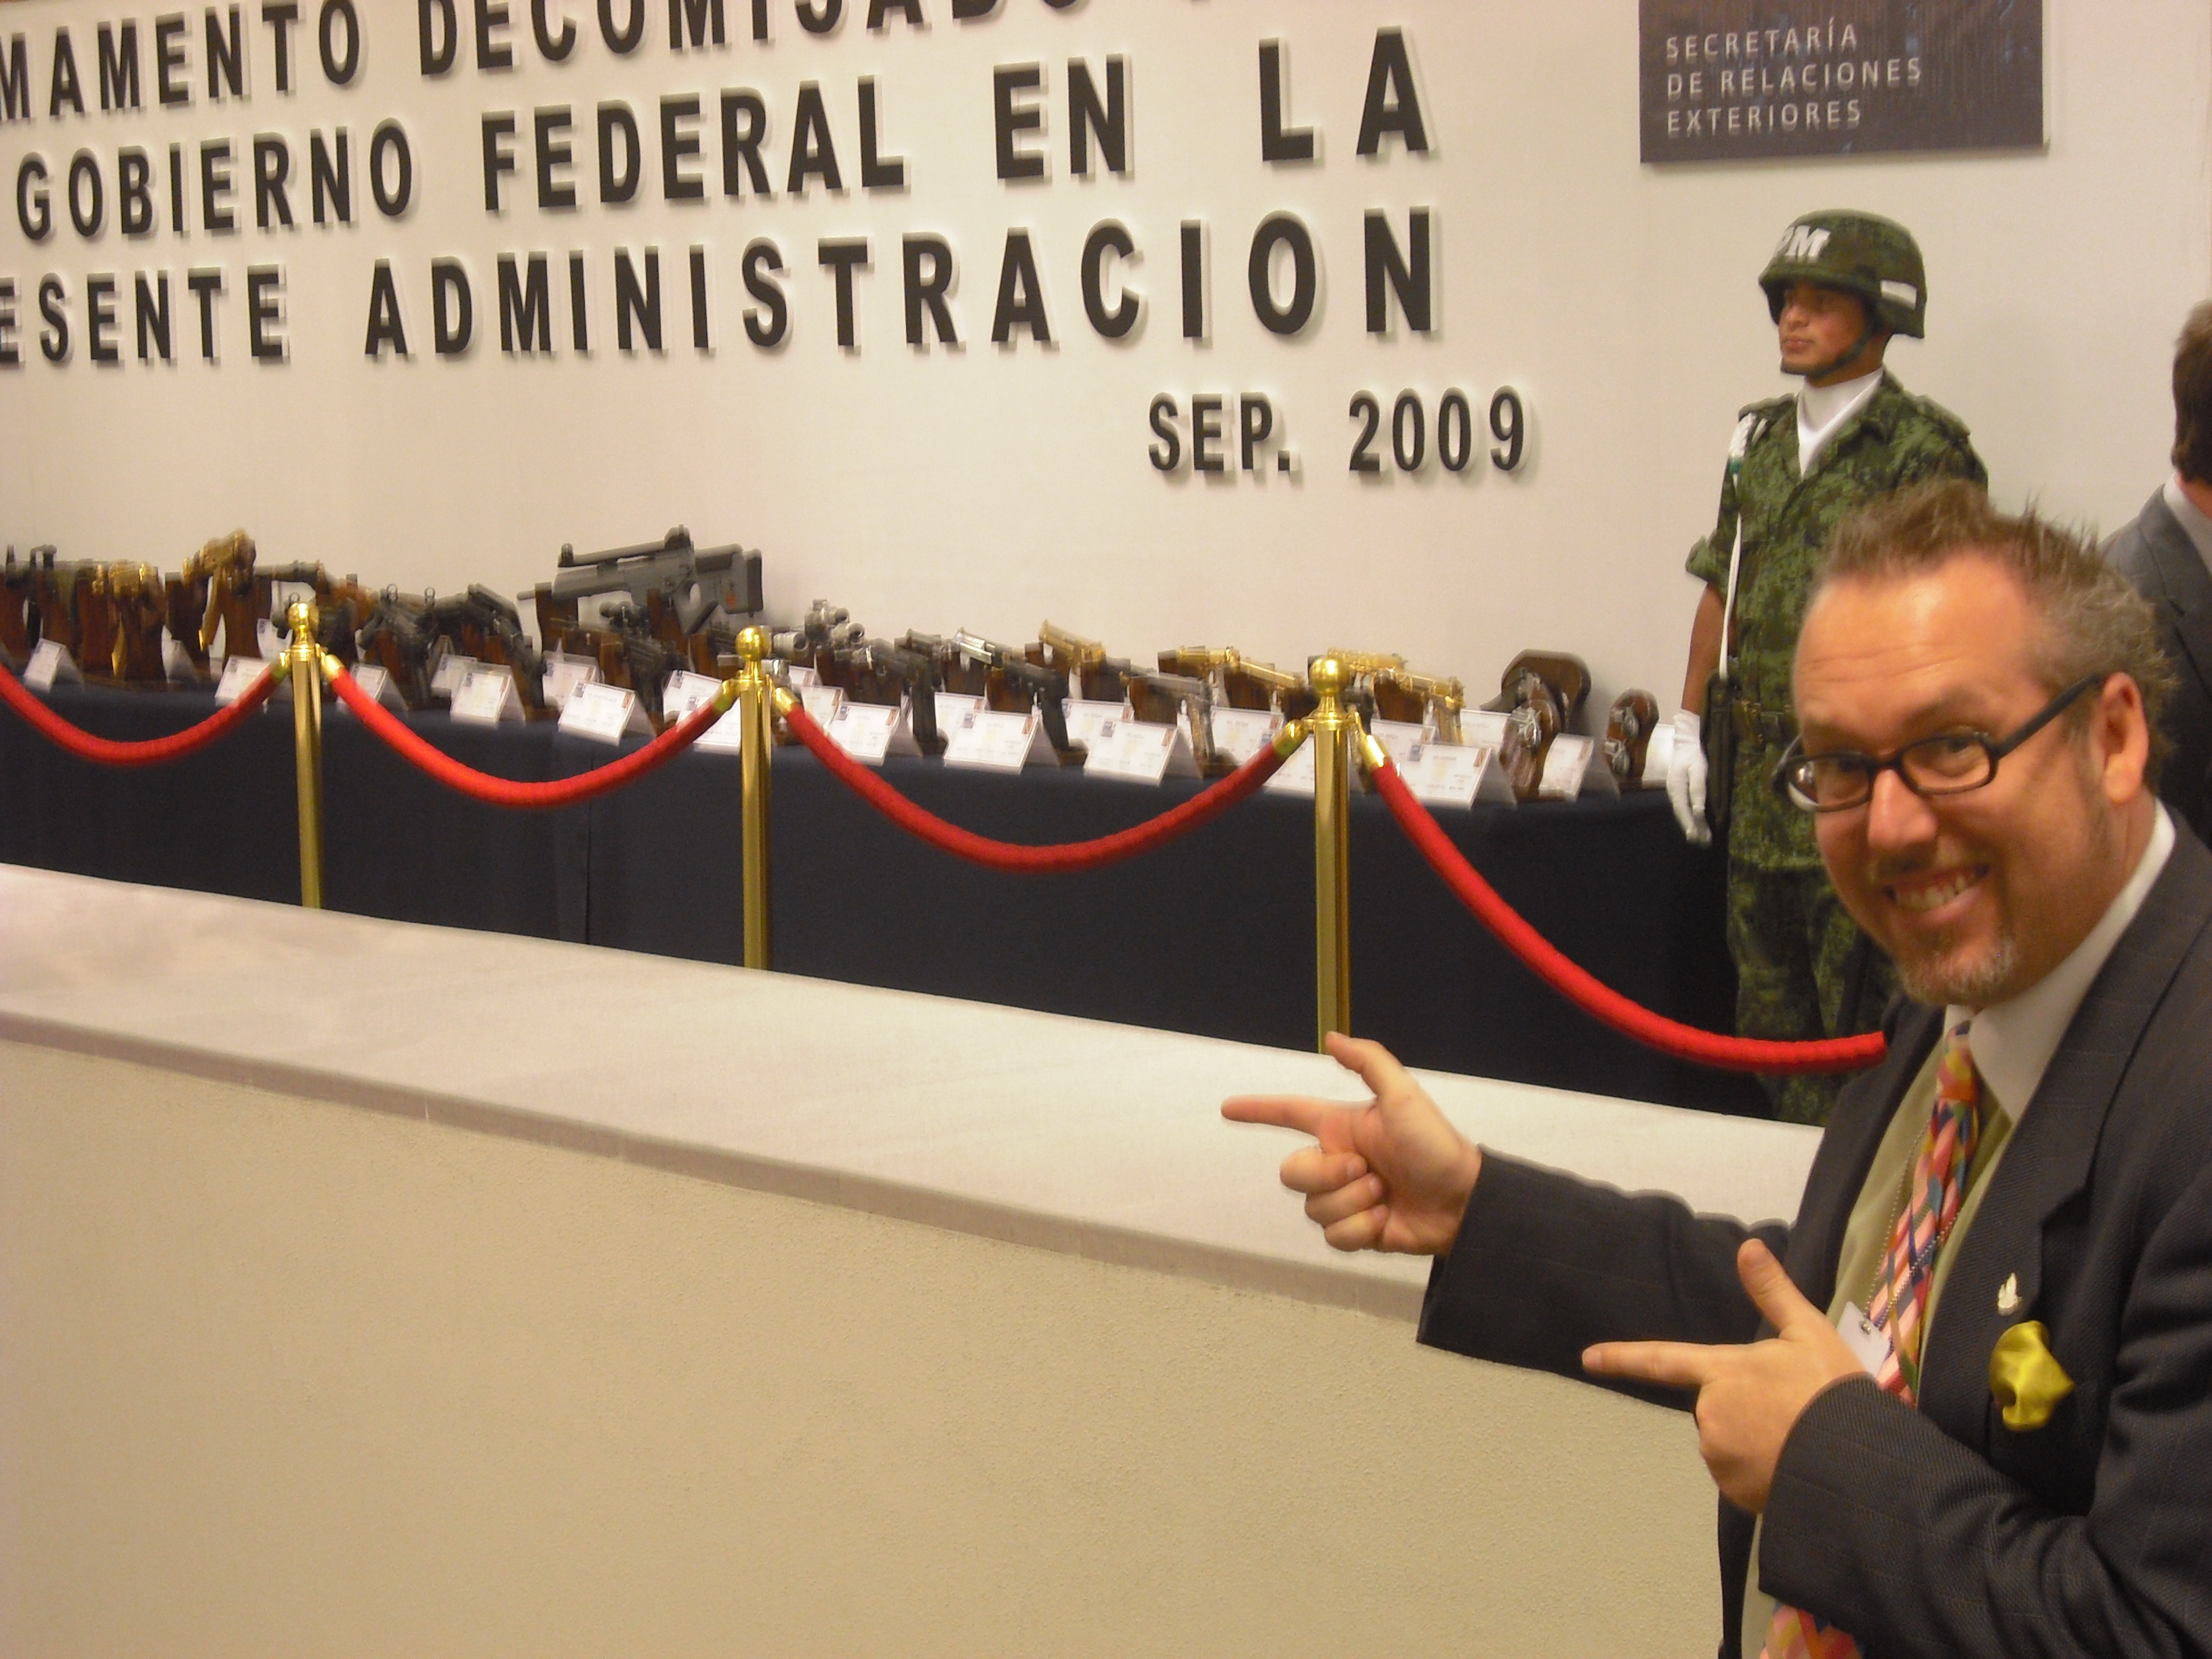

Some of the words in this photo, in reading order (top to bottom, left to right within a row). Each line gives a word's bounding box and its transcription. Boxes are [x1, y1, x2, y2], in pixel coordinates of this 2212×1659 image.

[0, 0, 361, 121] MAMENTO
[1666, 17, 1858, 65] SECRETARÍA
[1667, 73, 1703, 100] DE
[1721, 57, 1922, 97] RELACIONES
[16, 119, 413, 241] GOBIERNO
[480, 77, 906, 213] FEDERAL
[993, 56, 1128, 180] EN
[1258, 28, 1429, 163] LA
[1667, 99, 1862, 138] EXTERIORES
[365, 207, 1432, 359] ADMINISTRACION
[1149, 392, 1291, 476] SEP.
[1348, 386, 1525, 476] 2009
